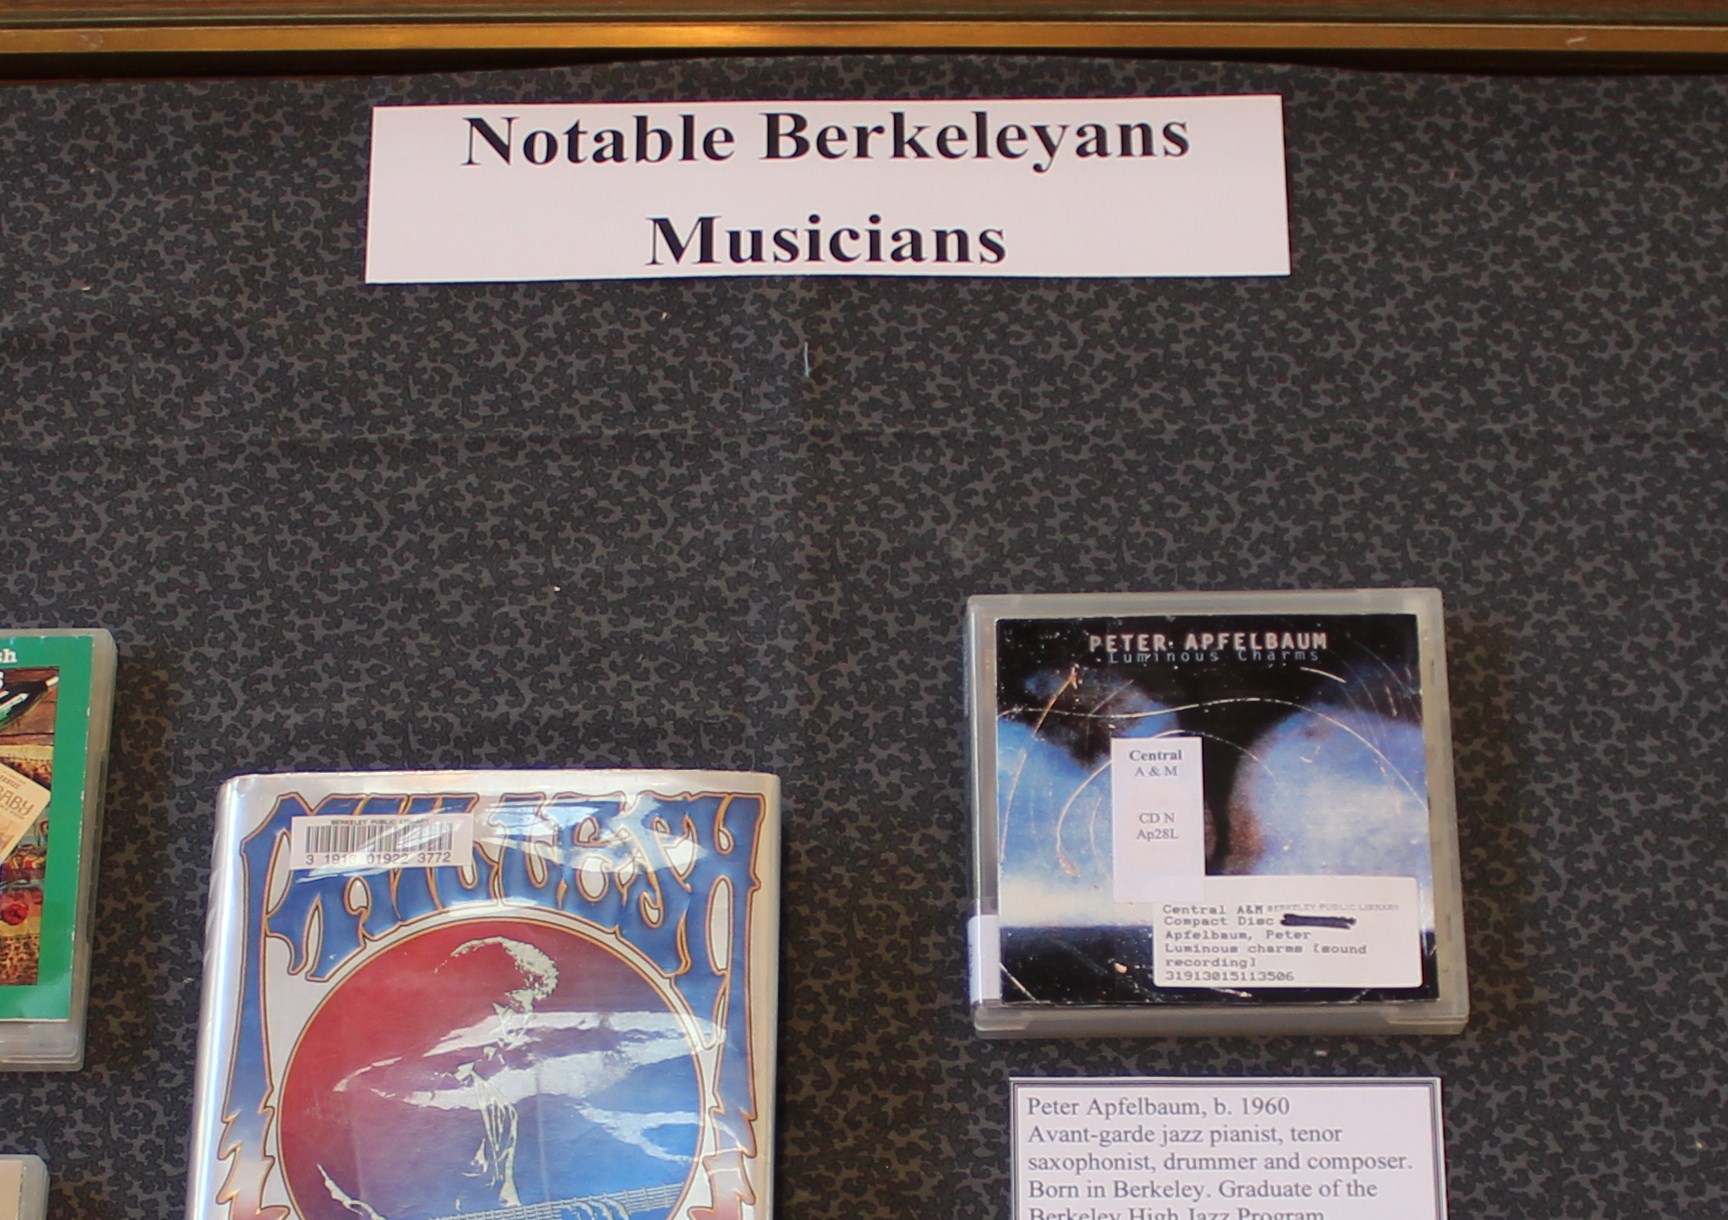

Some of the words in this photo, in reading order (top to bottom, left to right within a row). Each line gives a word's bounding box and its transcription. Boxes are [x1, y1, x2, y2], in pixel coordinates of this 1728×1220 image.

[459, 113, 738, 168] Notable
[759, 110, 1191, 172] Berkeleyans
[644, 213, 1007, 268] Musicians
[1089, 635, 1166, 652] PETER
[1185, 633, 1327, 650] APFELBAUM
[1165, 943, 1238, 954] Luminous
[1248, 943, 1303, 954] charms
[1026, 1096, 1080, 1116] Peter
[1085, 1096, 1208, 1121] Apfelbaum,
[1212, 1097, 1233, 1116] b.
[1241, 1096, 1291, 1116] 1960
[1027, 1151, 1157, 1176] saxophonist,
[1162, 1151, 1258, 1171] drummer
[1263, 1151, 1301, 1171] and
[1306, 1156, 1413, 1175] composer.
